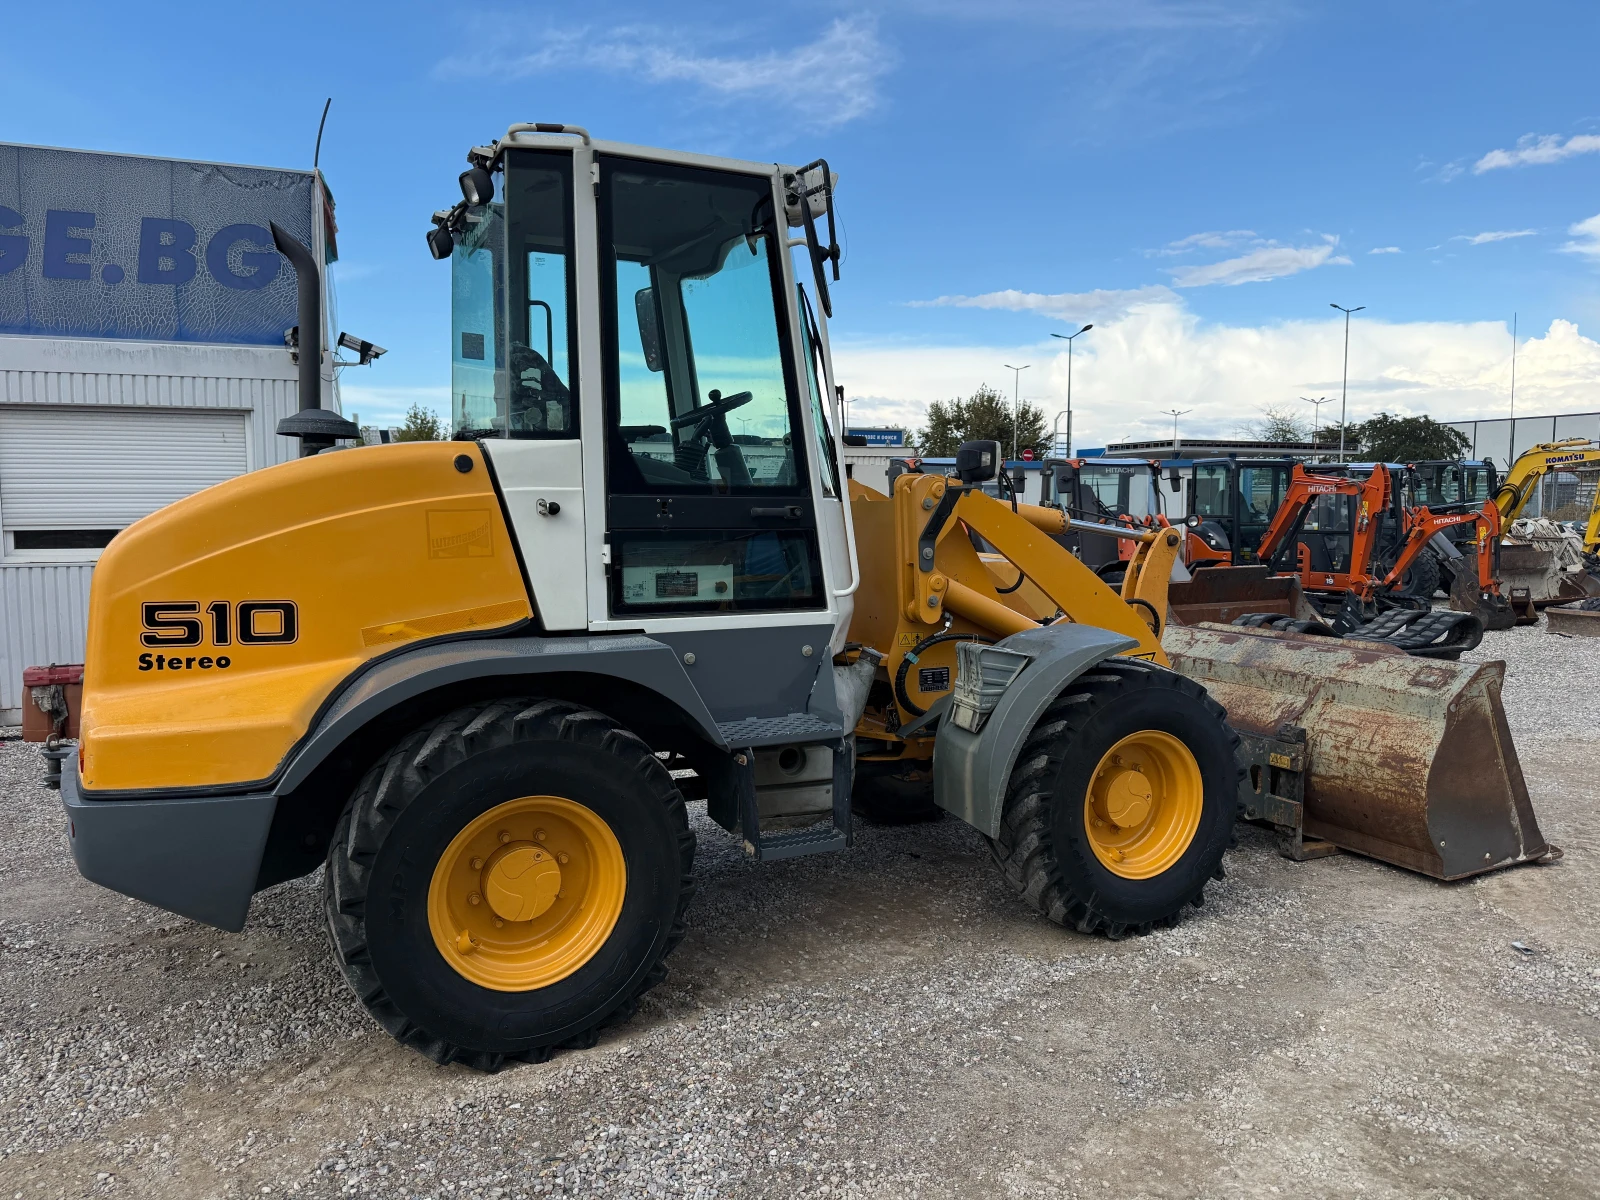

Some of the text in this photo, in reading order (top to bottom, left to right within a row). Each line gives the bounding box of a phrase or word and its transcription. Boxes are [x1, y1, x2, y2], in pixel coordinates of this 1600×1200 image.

[1546, 453, 1584, 464] KOMATSU
[1434, 516, 1460, 524] HITACHI
[140, 600, 299, 647] 510
[138, 652, 231, 671] Stereo
